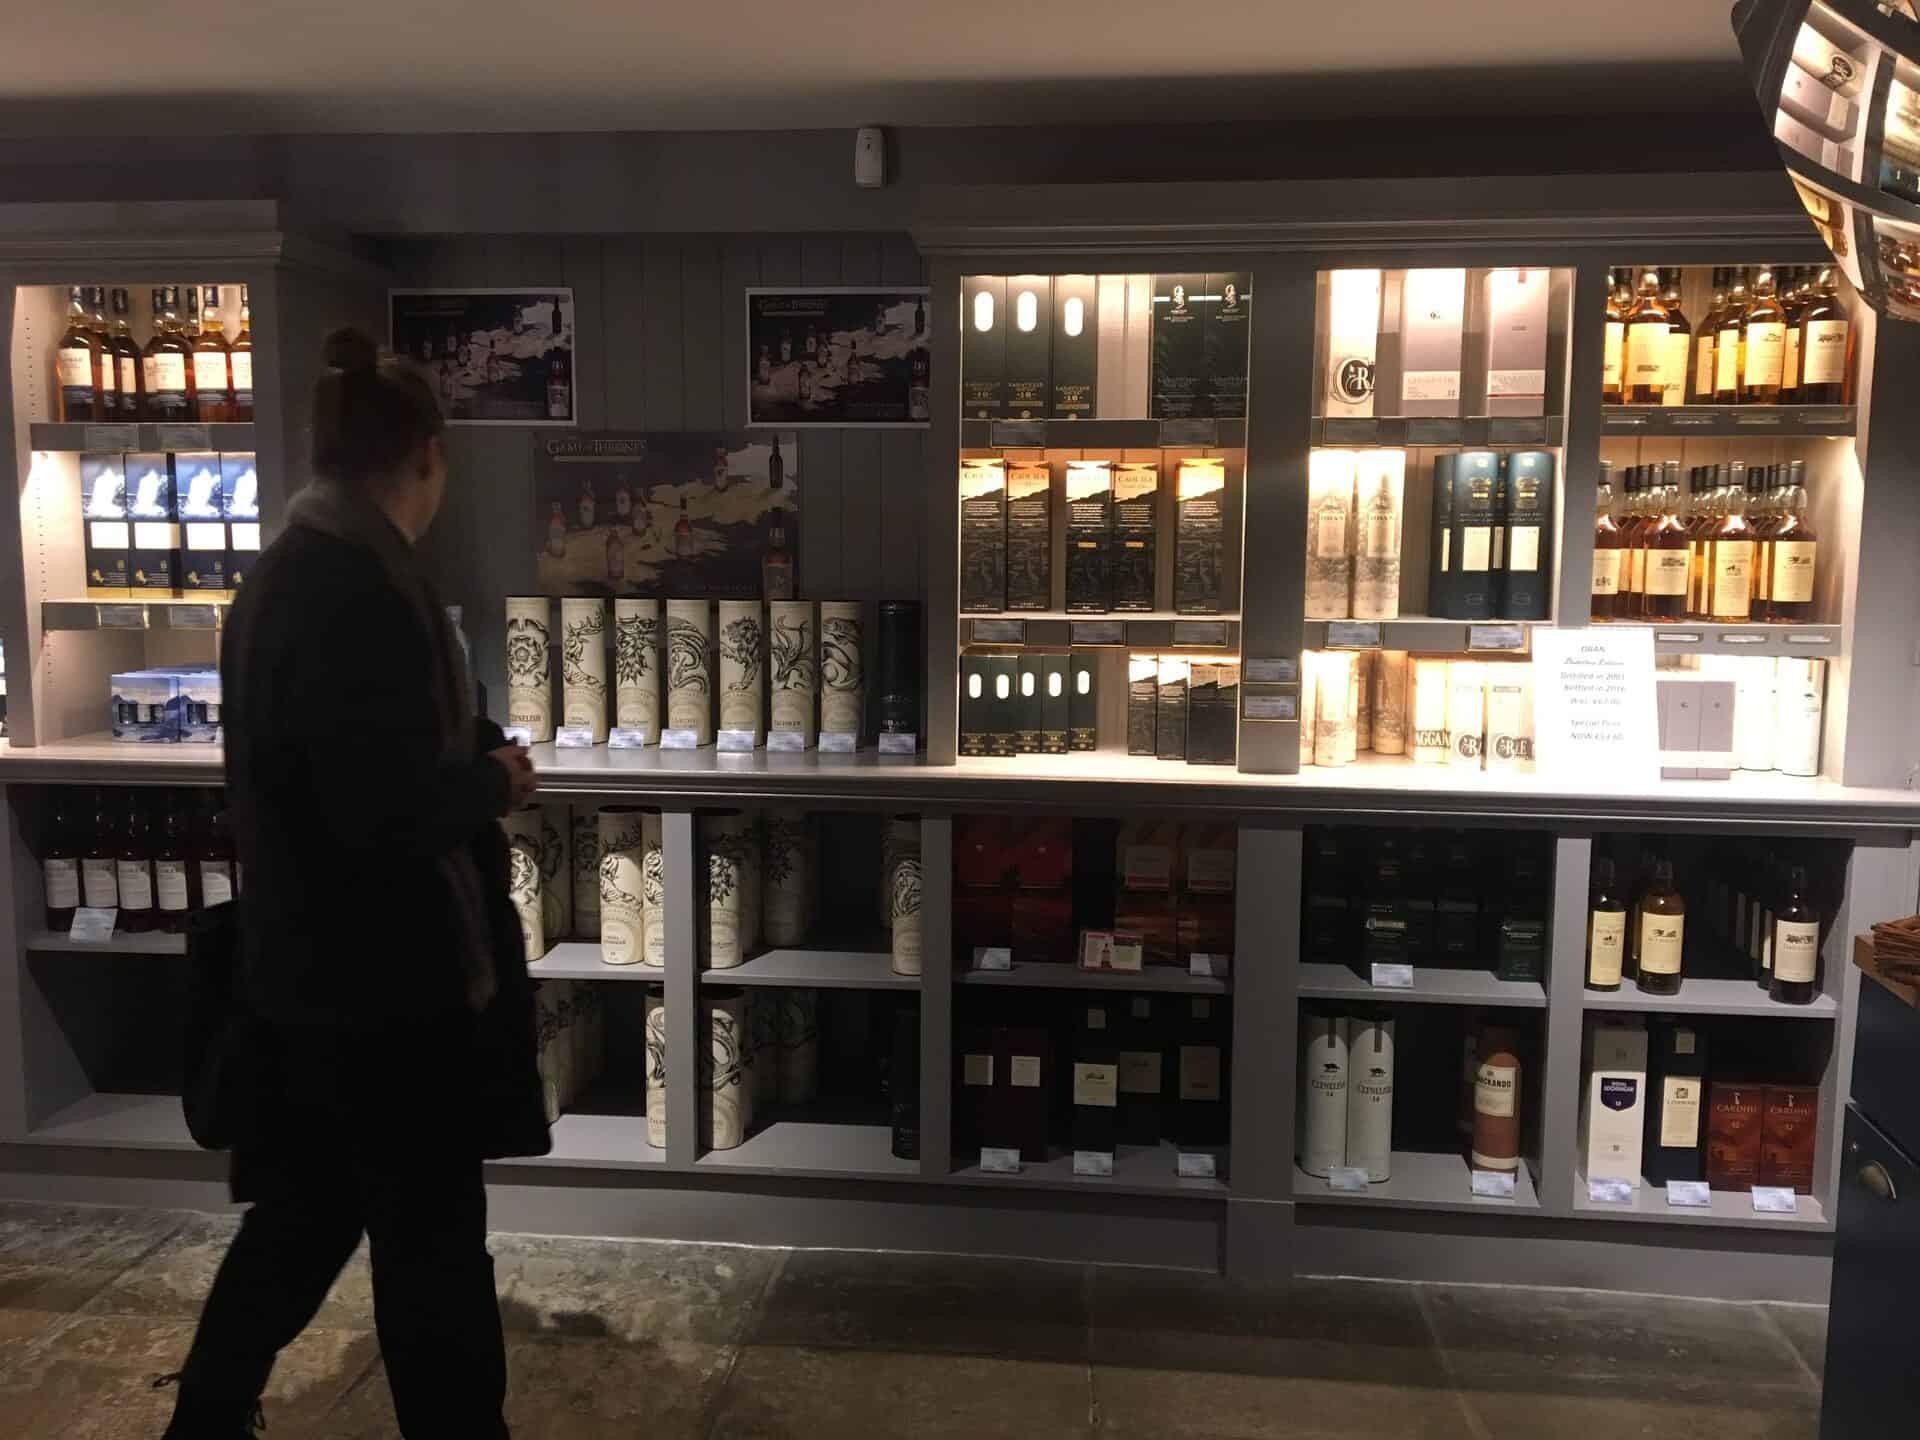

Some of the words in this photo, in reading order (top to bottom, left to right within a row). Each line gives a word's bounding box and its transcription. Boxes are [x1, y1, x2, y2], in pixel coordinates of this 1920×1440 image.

[1580, 645, 1606, 654] OBAN
[1560, 671, 1594, 680] Distilled
[1563, 684, 1594, 692] Bottled
[1570, 719, 1600, 729] Special
